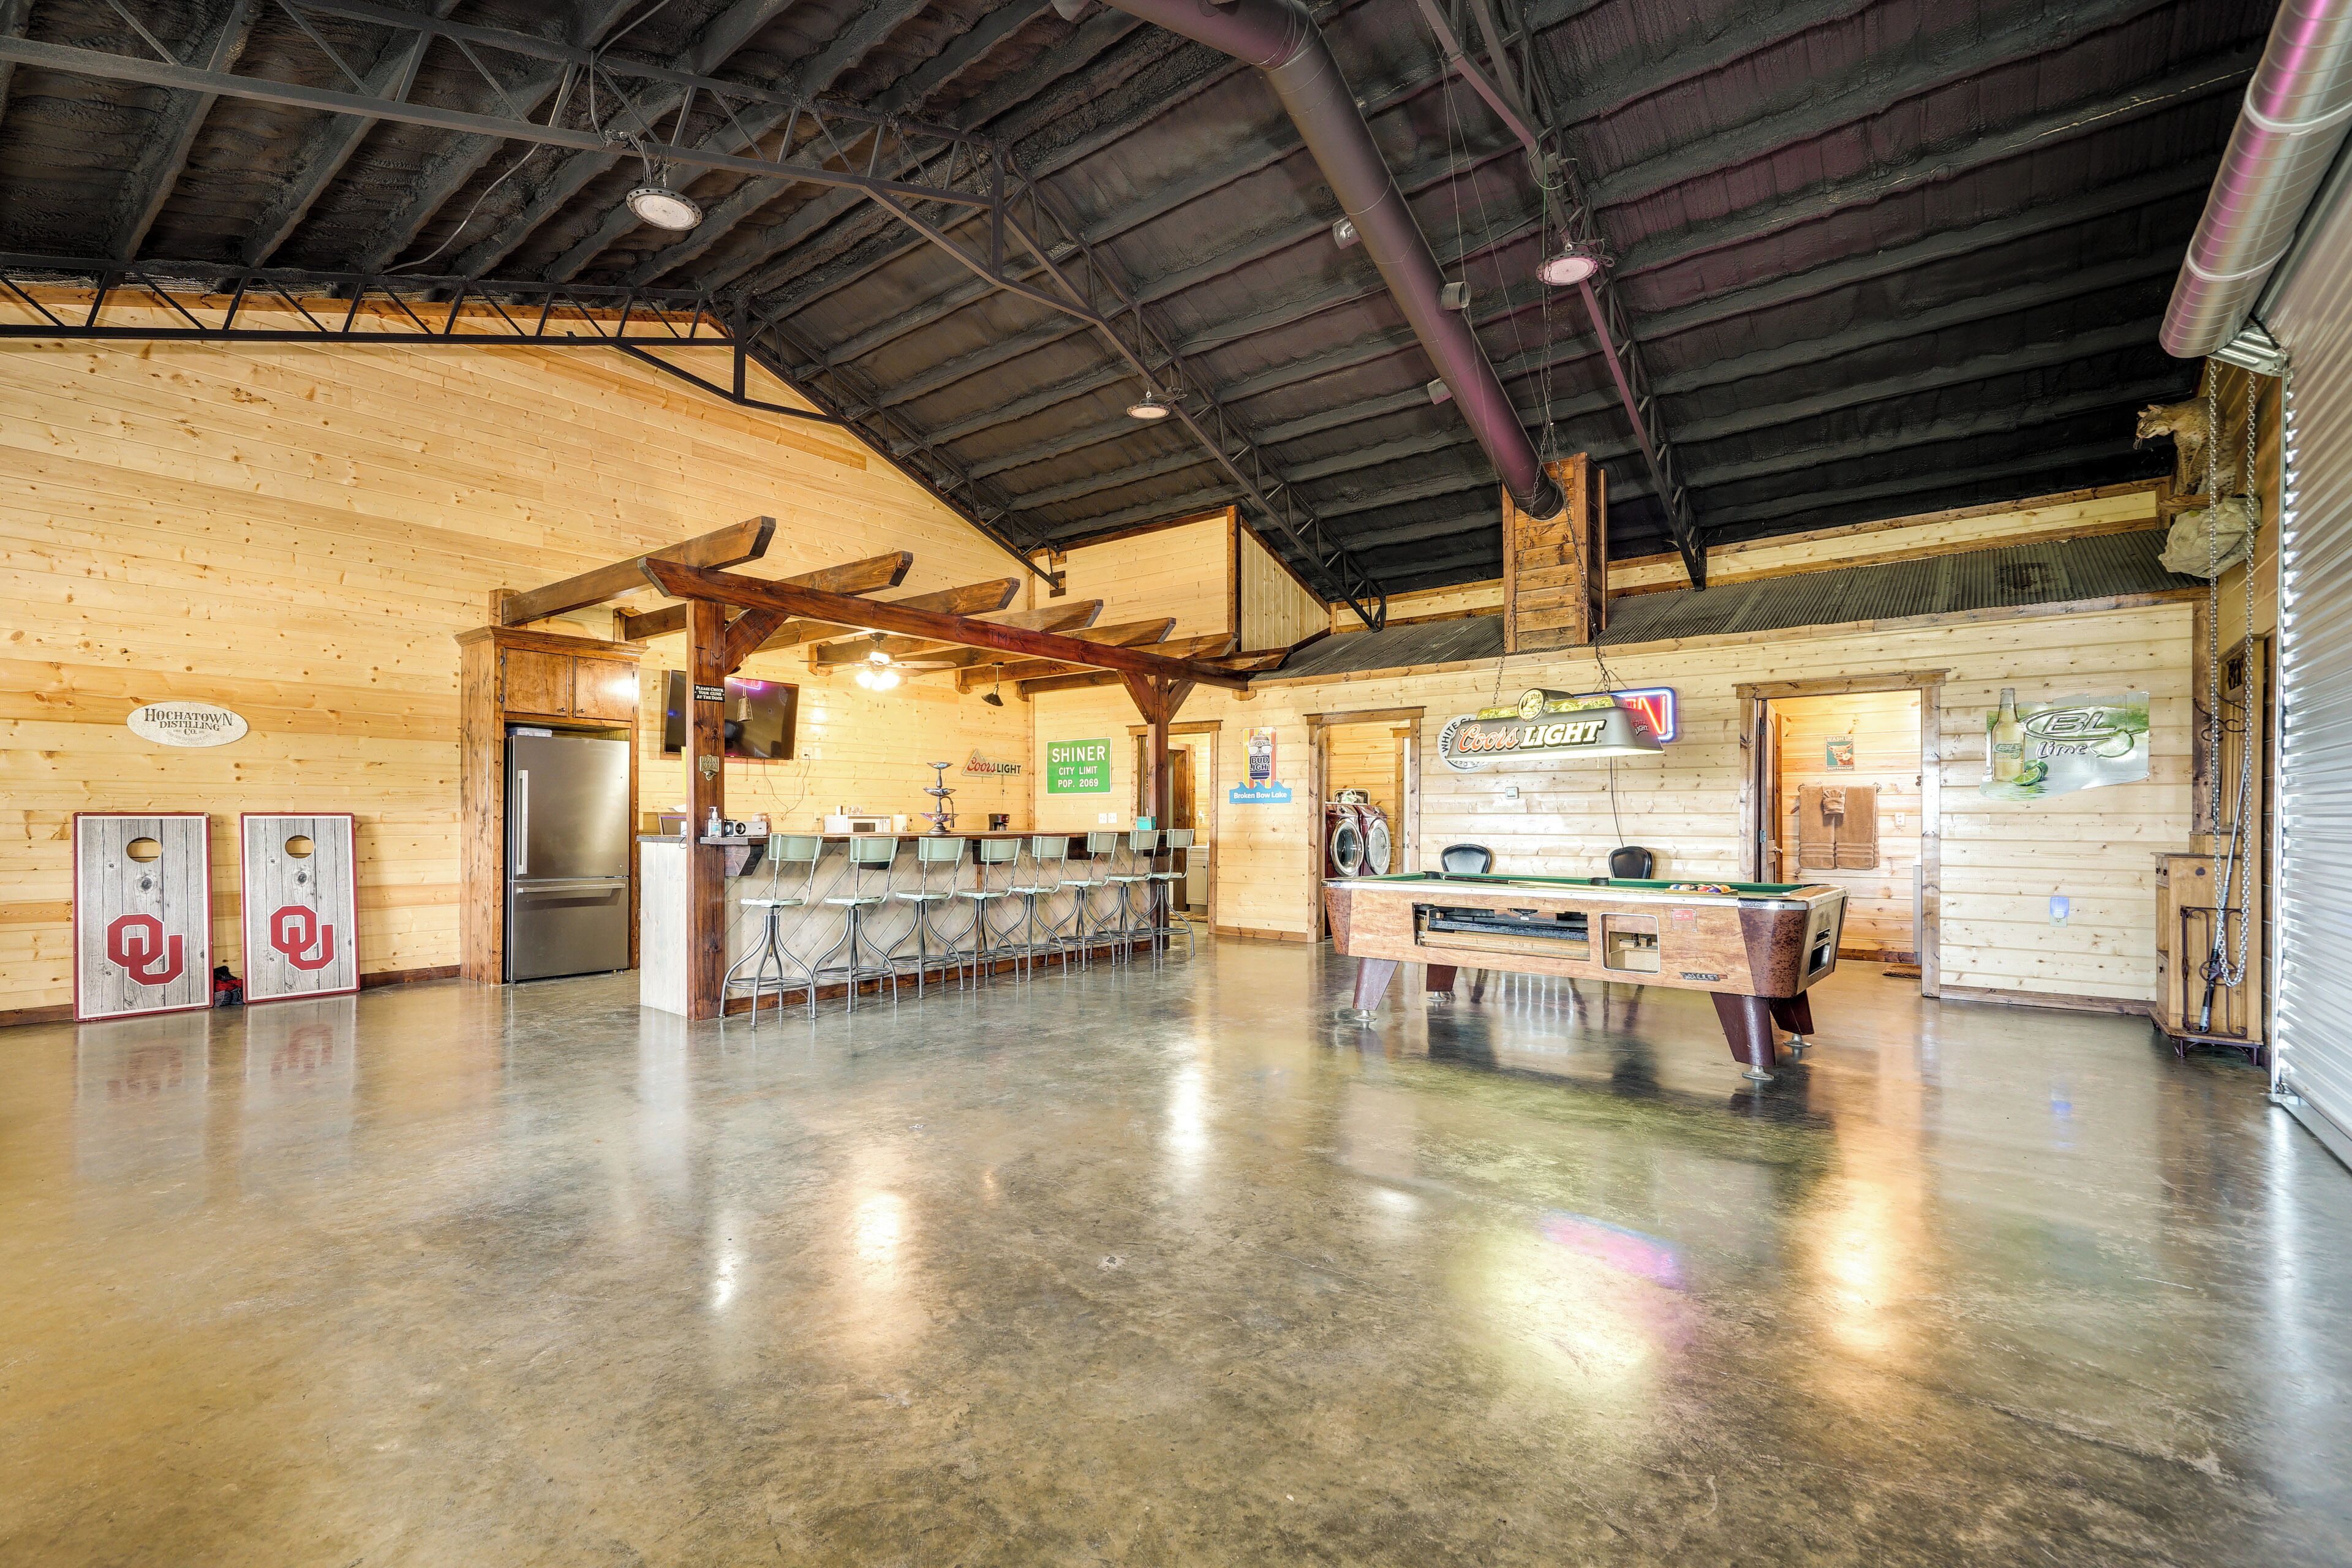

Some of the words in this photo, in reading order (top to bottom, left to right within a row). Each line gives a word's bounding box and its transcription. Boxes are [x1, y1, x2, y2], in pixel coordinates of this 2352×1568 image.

[144, 708, 233, 726] HOCHATOWN
[159, 720, 220, 731] DISTILLING
[2041, 711, 2117, 734] BL
[1441, 722, 1458, 753] WHITE
[1458, 723, 1520, 753] Coors
[1519, 719, 1607, 749] LIGHT
[1635, 725, 1649, 736] LIGHT
[1052, 745, 1106, 763] SHINER
[2037, 741, 2087, 758] Lime
[967, 757, 996, 772] Coors
[997, 763, 1022, 774] LIGHT
[1058, 767, 1075, 775] CITY
[1079, 766, 1098, 775] LIMIT
[1058, 779, 1075, 788] POP.
[1079, 778, 1099, 787] 2069
